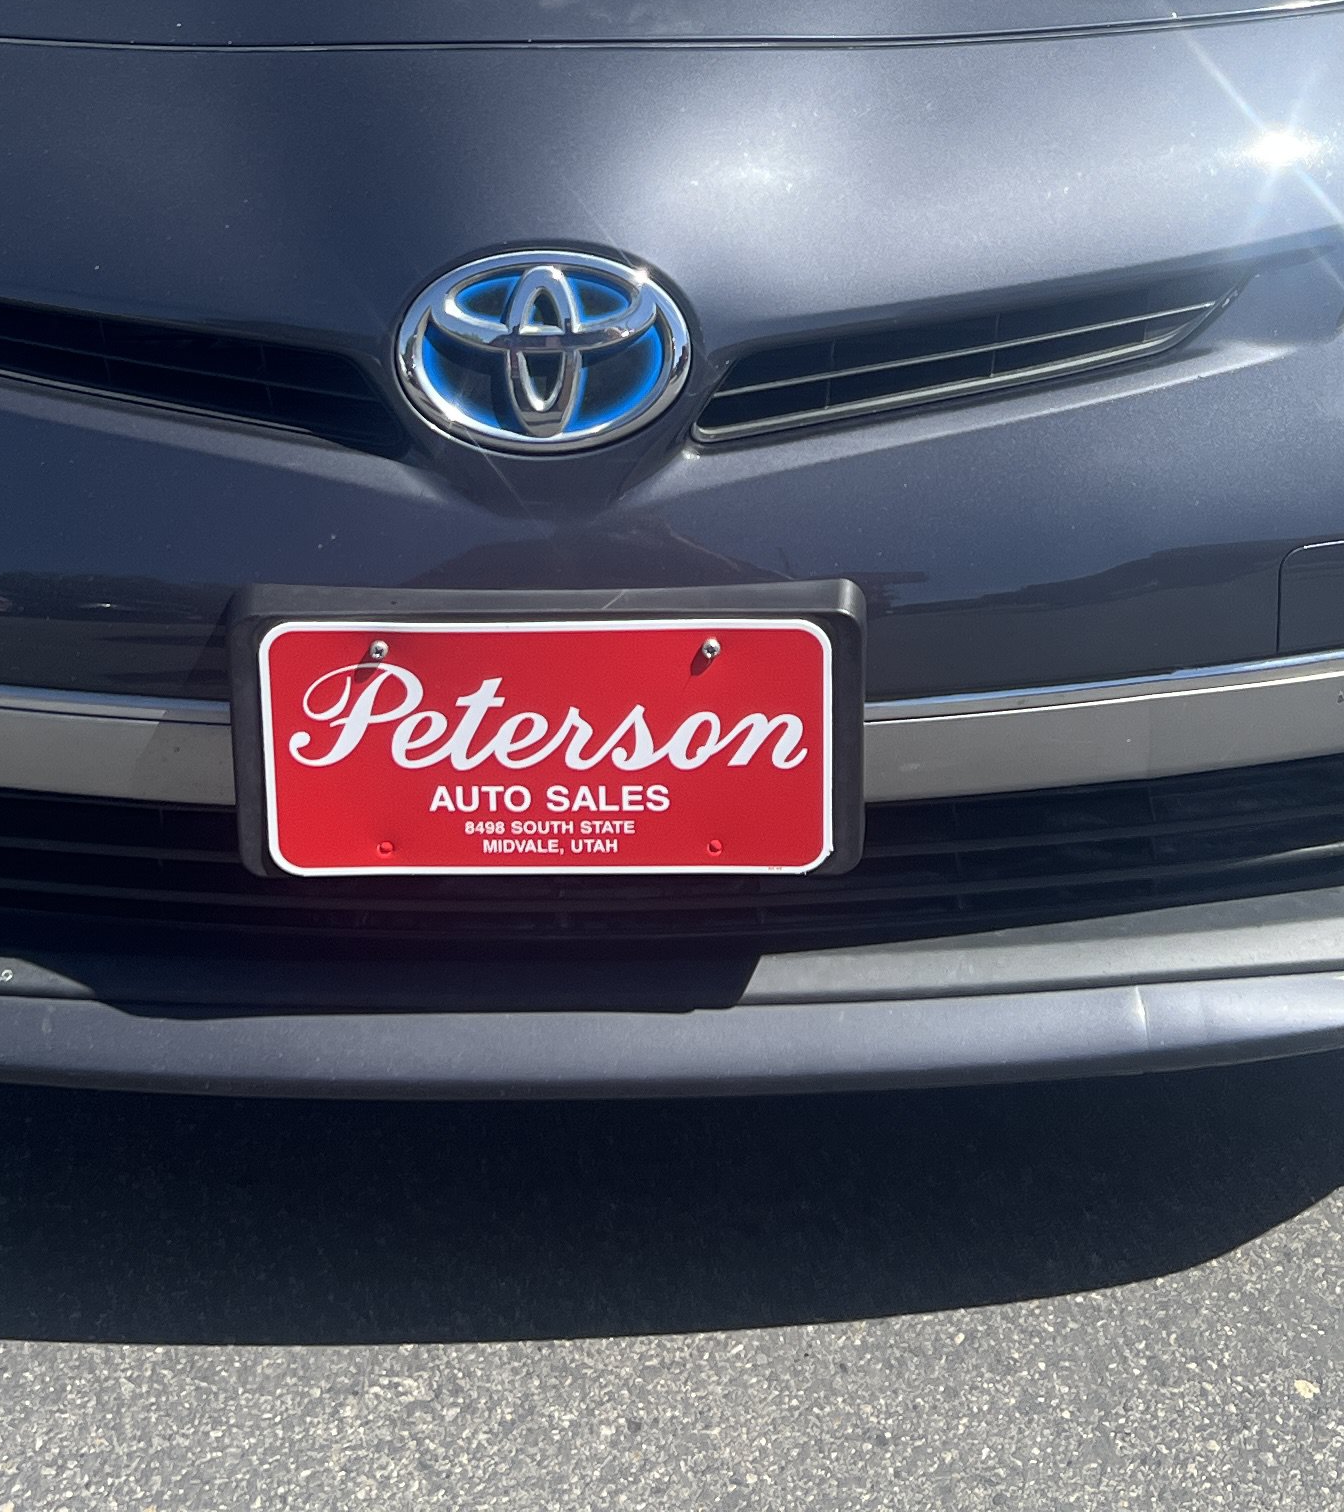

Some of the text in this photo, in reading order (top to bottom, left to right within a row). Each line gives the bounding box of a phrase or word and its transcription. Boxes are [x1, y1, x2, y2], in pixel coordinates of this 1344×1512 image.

[288, 662, 808, 771] Peterson
[430, 784, 670, 813] AUTO SALES
[464, 820, 636, 835] 8498 SOUTH STATE
[483, 839, 618, 856] MIDVALE, UTAH
